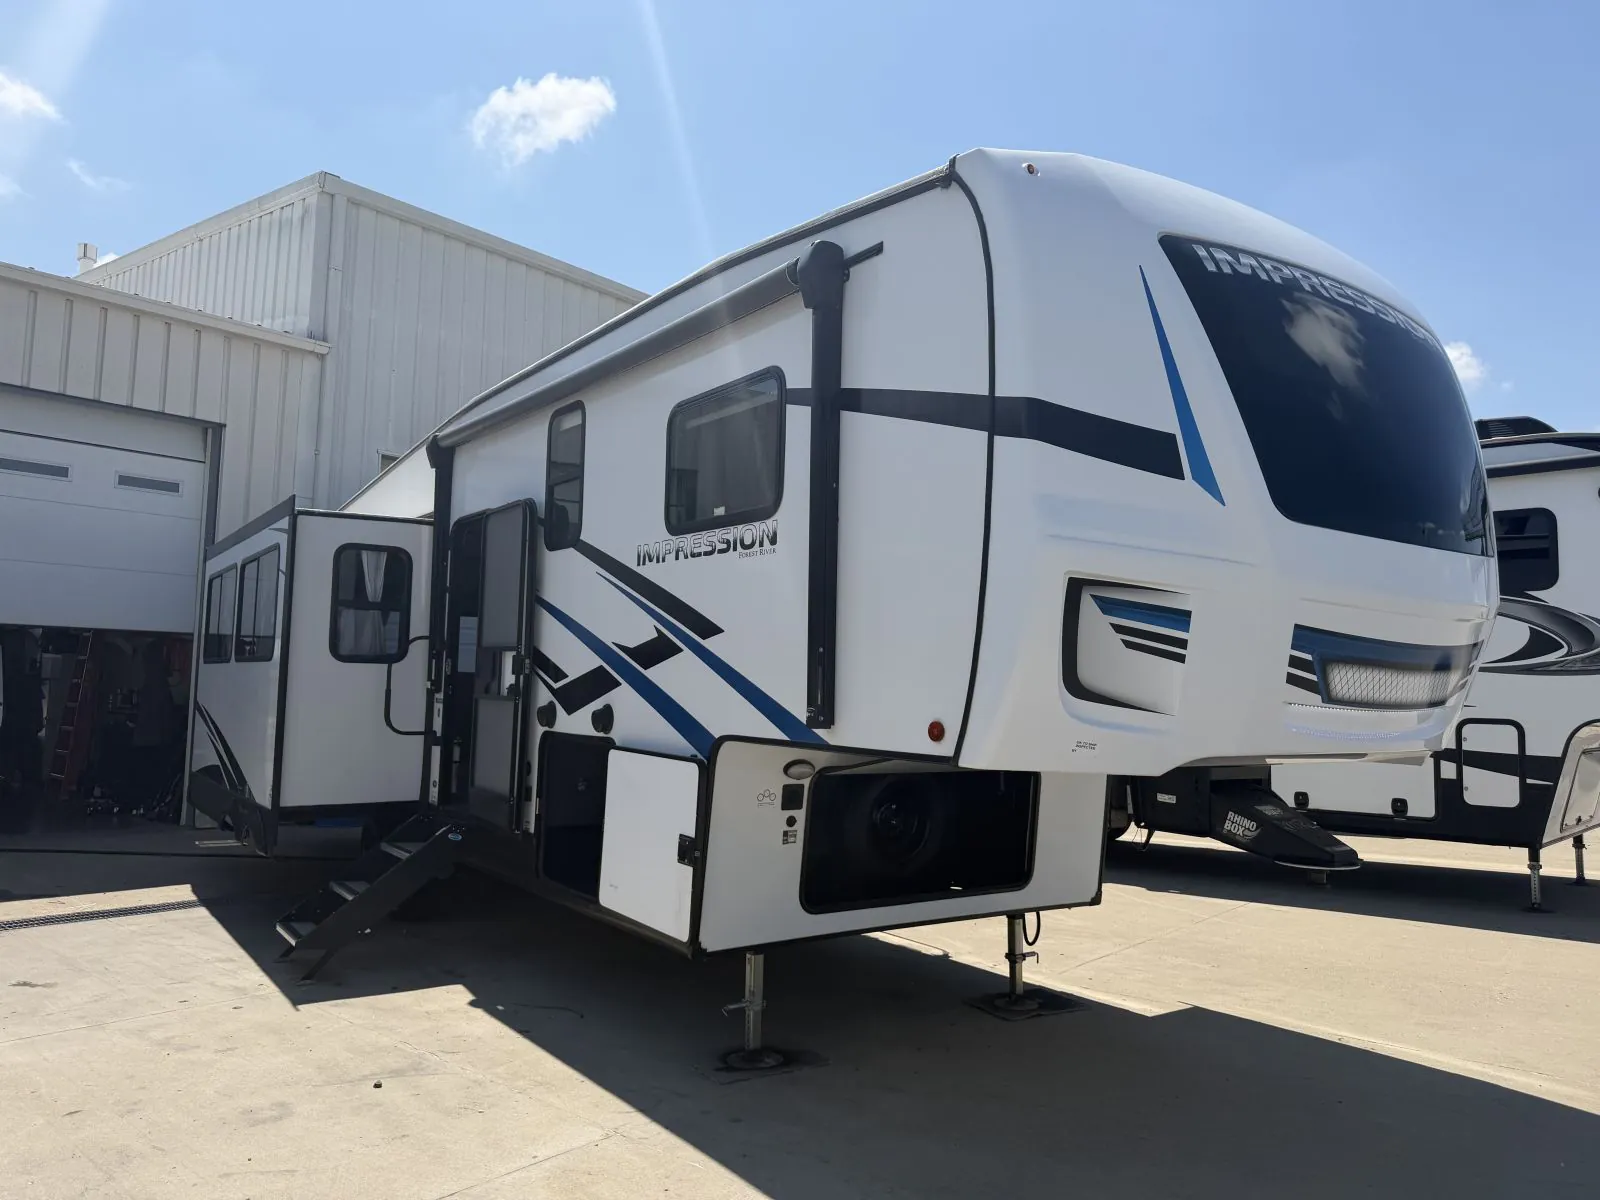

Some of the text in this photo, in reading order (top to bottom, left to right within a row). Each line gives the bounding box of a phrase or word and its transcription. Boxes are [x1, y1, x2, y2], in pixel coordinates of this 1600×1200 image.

[636, 519, 778, 567] IMPRESSION
[760, 548, 776, 556] RIVER
[1224, 820, 1245, 836] BOX
[1227, 811, 1257, 831] RHINO
